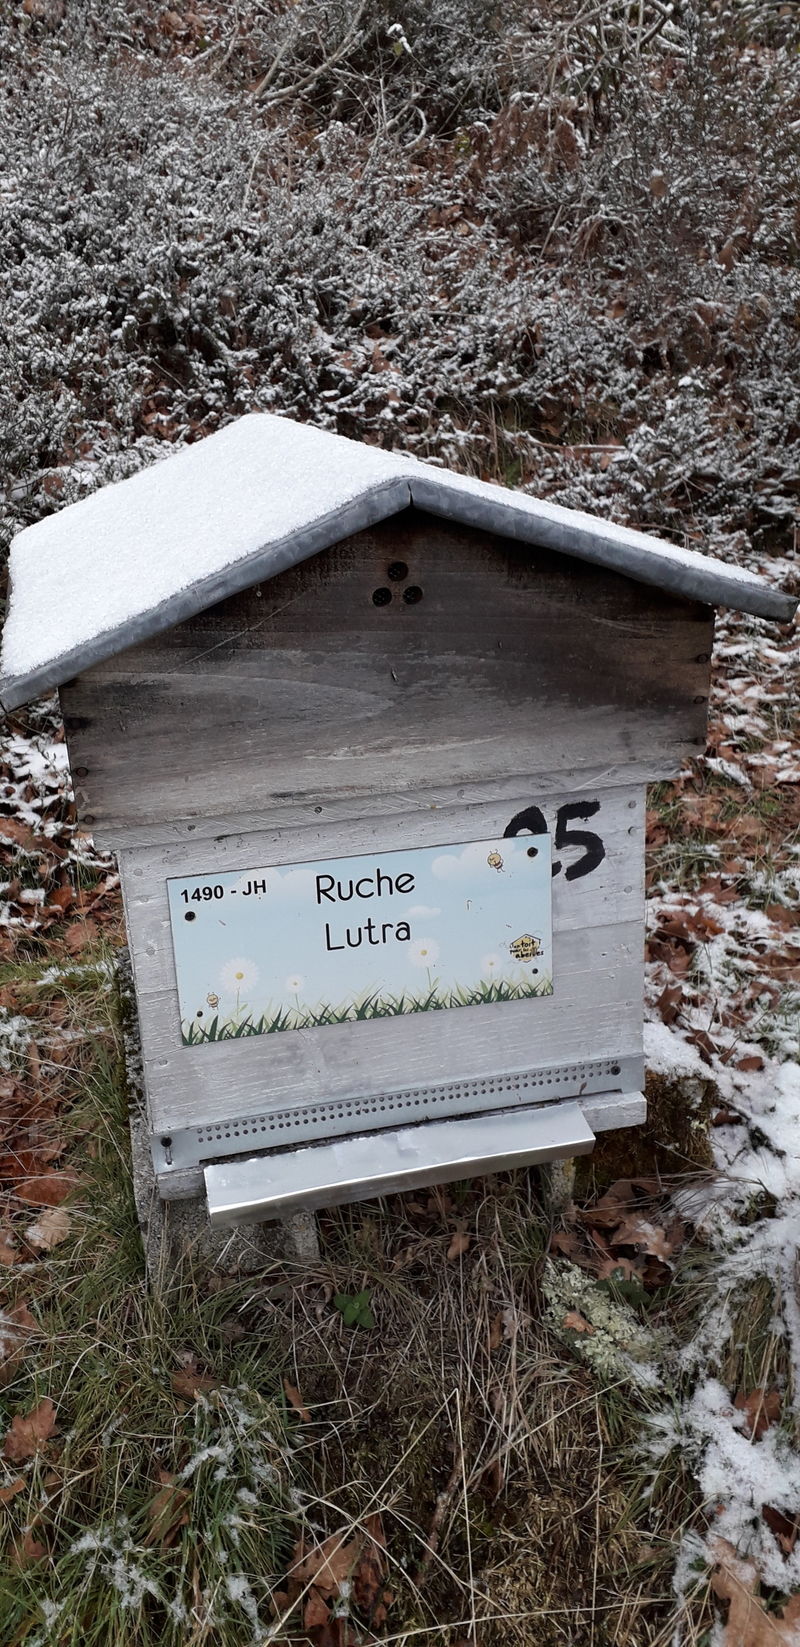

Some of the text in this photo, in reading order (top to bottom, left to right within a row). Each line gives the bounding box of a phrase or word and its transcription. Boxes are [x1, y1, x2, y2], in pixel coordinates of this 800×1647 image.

[180, 884, 224, 904] 1490
[242, 879, 267, 896] JH
[315, 867, 415, 905] Ruche
[325, 917, 411, 951] Lutra
